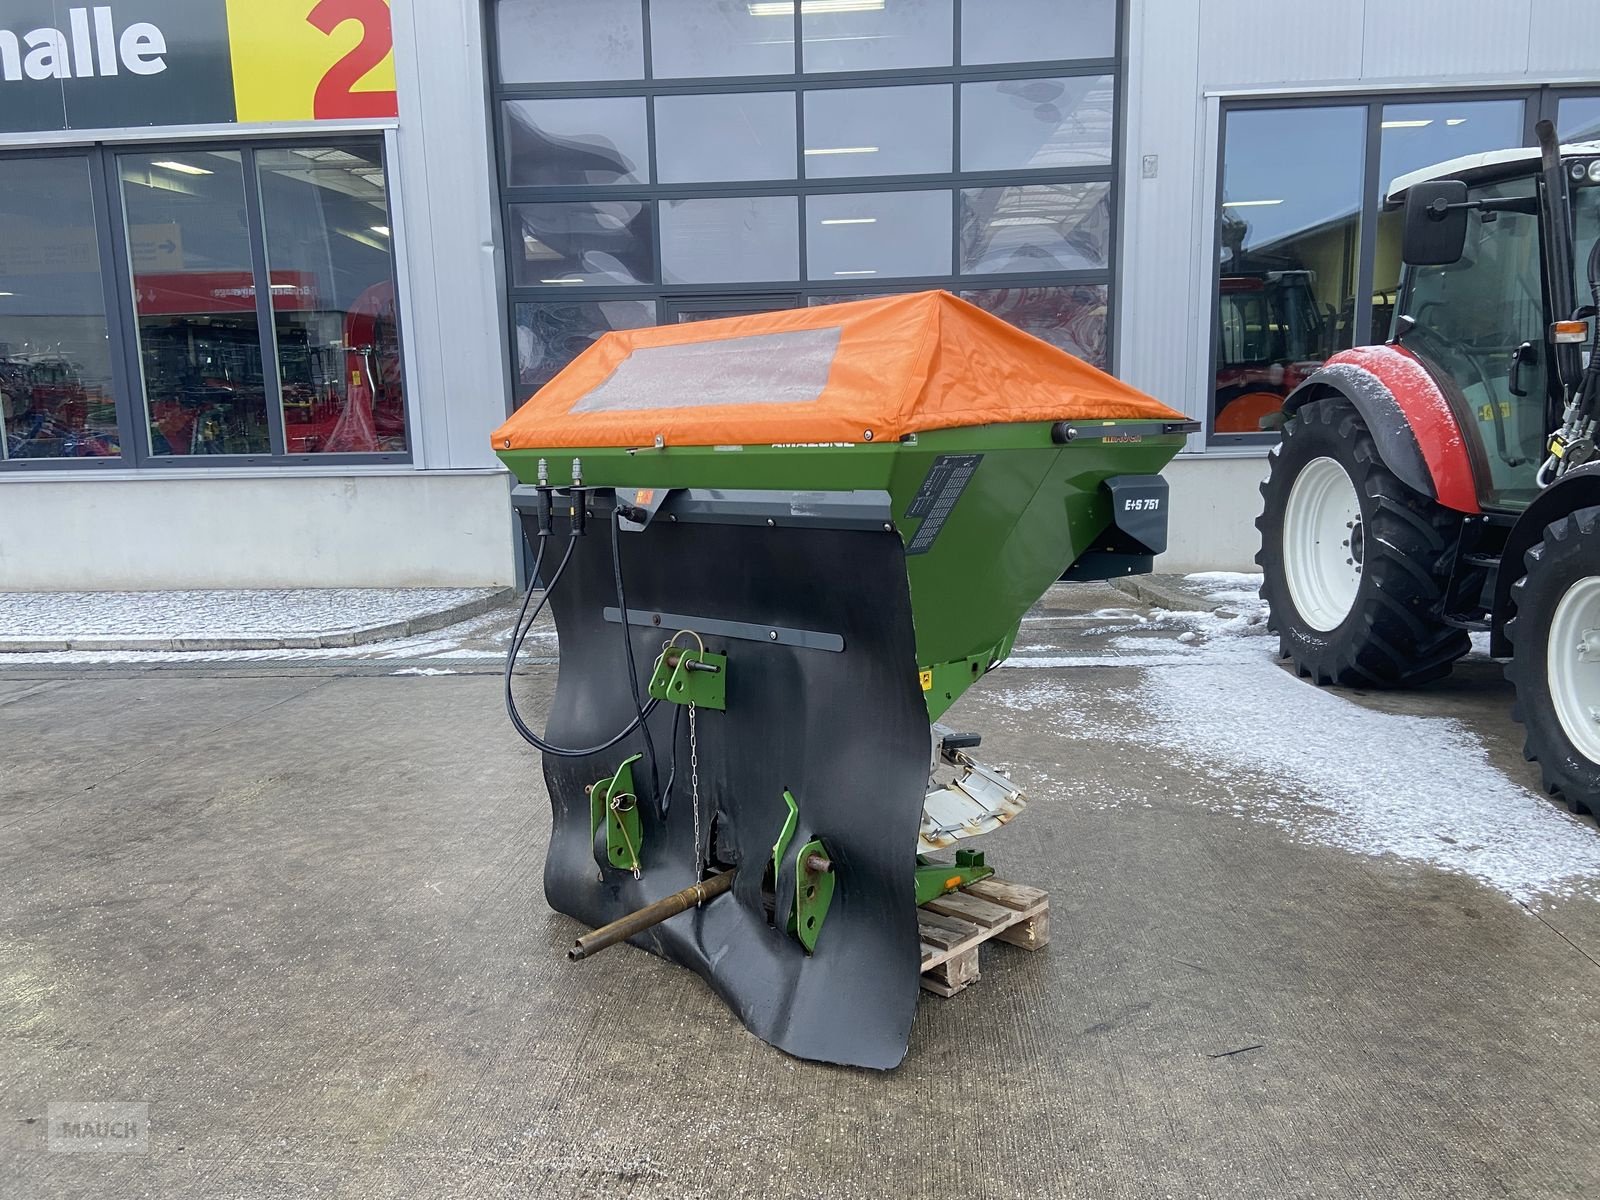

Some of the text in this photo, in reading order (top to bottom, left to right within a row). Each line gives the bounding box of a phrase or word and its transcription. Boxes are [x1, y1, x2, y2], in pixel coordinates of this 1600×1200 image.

[306, 0, 399, 119] 2
[1124, 498, 1160, 511] E+S 751
